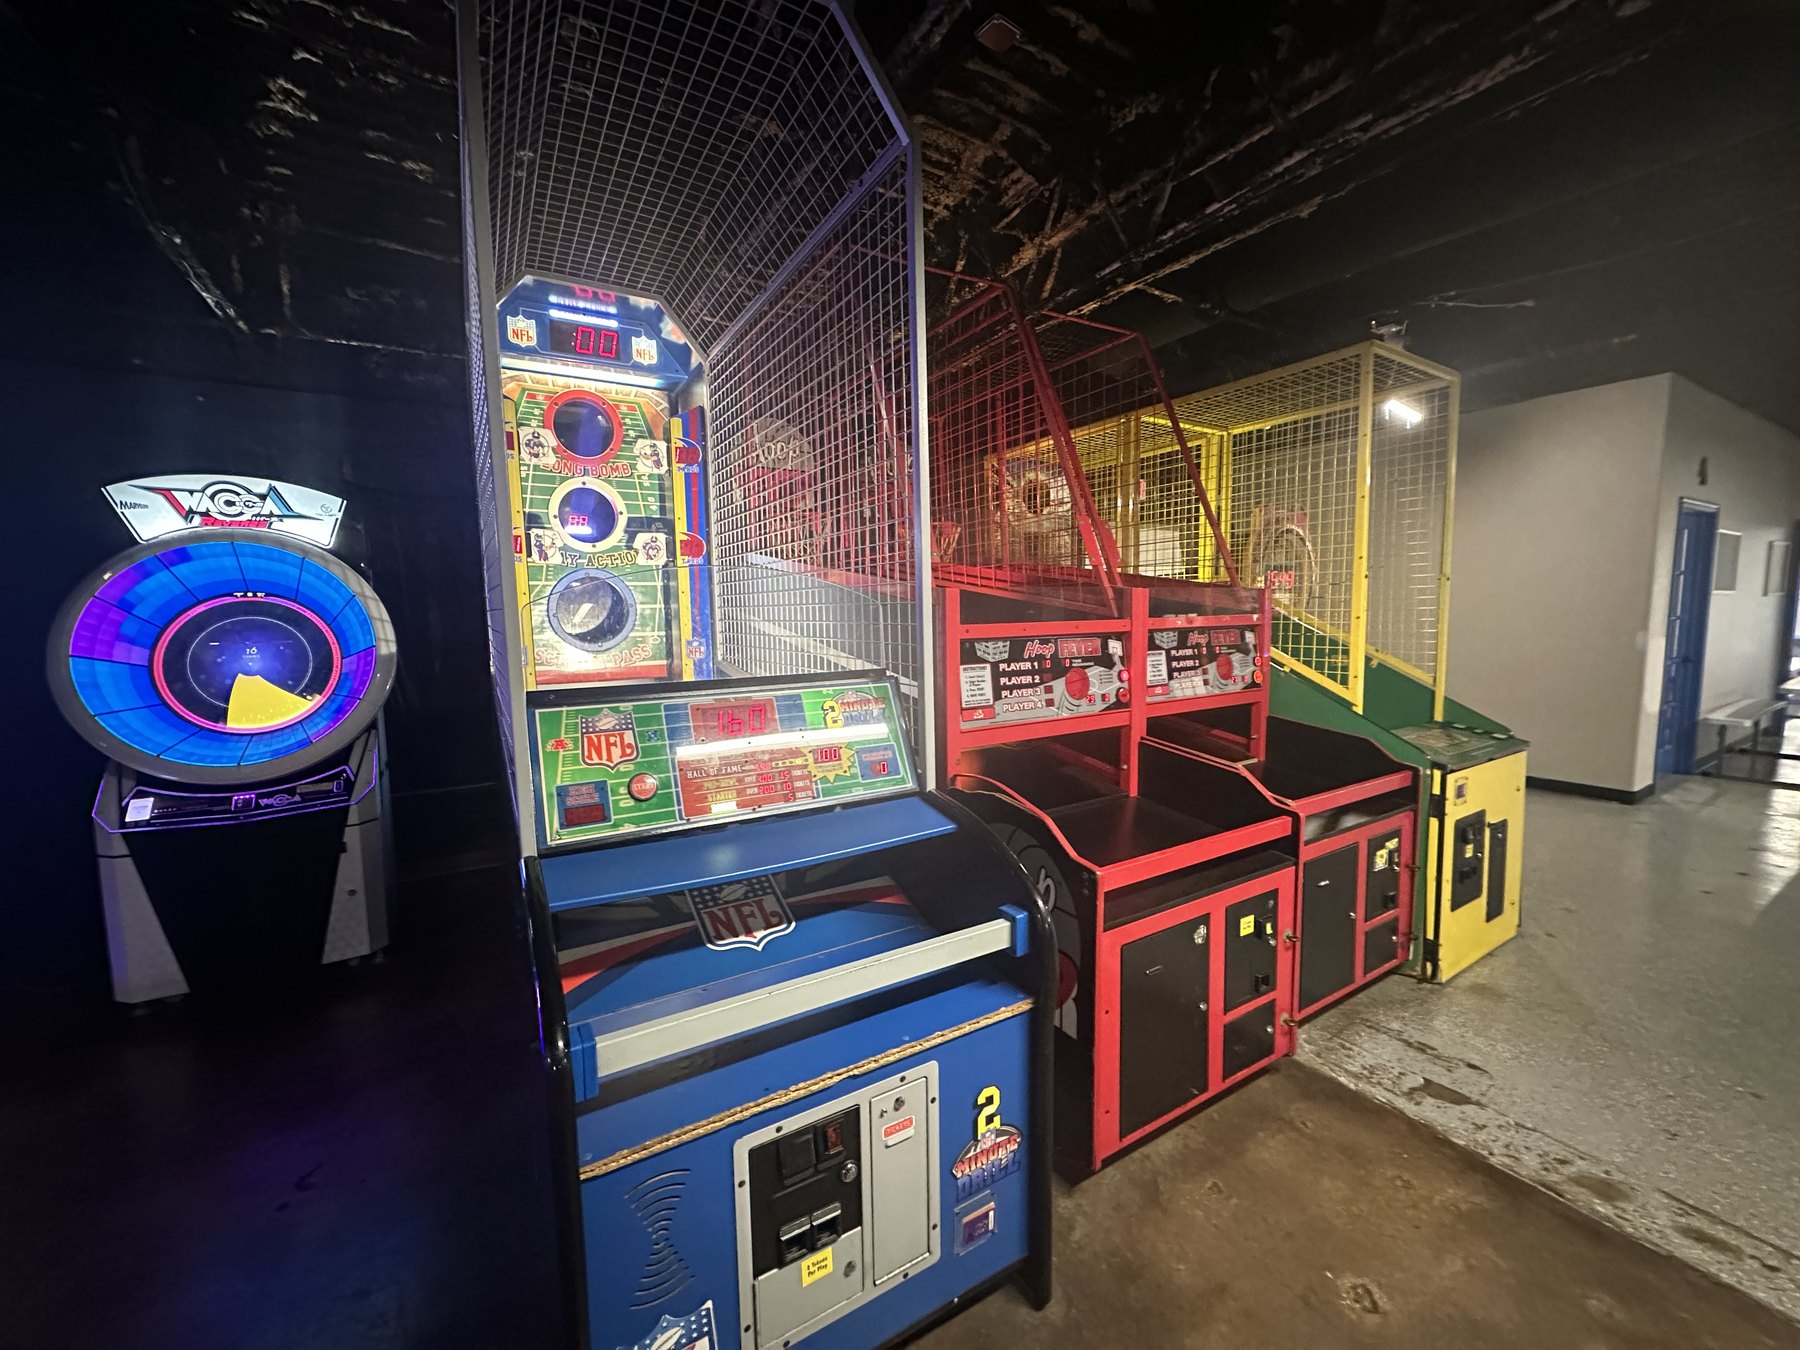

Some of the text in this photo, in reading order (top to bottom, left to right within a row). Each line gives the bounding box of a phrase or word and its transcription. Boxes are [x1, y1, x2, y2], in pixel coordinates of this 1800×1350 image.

[511, 328, 534, 342] NFL
[635, 347, 655, 360] NFL
[589, 462, 632, 478] BOMB
[612, 645, 652, 667] PASS
[688, 646, 704, 658] NFL
[1024, 639, 1056, 659] Hoop
[999, 662, 1032, 671] PLAYER
[1000, 675, 1040, 685] PLAYER 2
[1001, 689, 1034, 698] PLAYER
[822, 700, 844, 729] 2
[1002, 702, 1035, 712] PLAYER
[585, 732, 635, 764] NFL
[817, 747, 839, 761] 100
[687, 769, 707, 779] HALL
[709, 767, 719, 775] OF
[722, 764, 743, 774] FAME
[703, 898, 785, 941] NFL
[976, 1085, 1001, 1140] 2
[956, 1132, 1021, 1178] MINUTE
